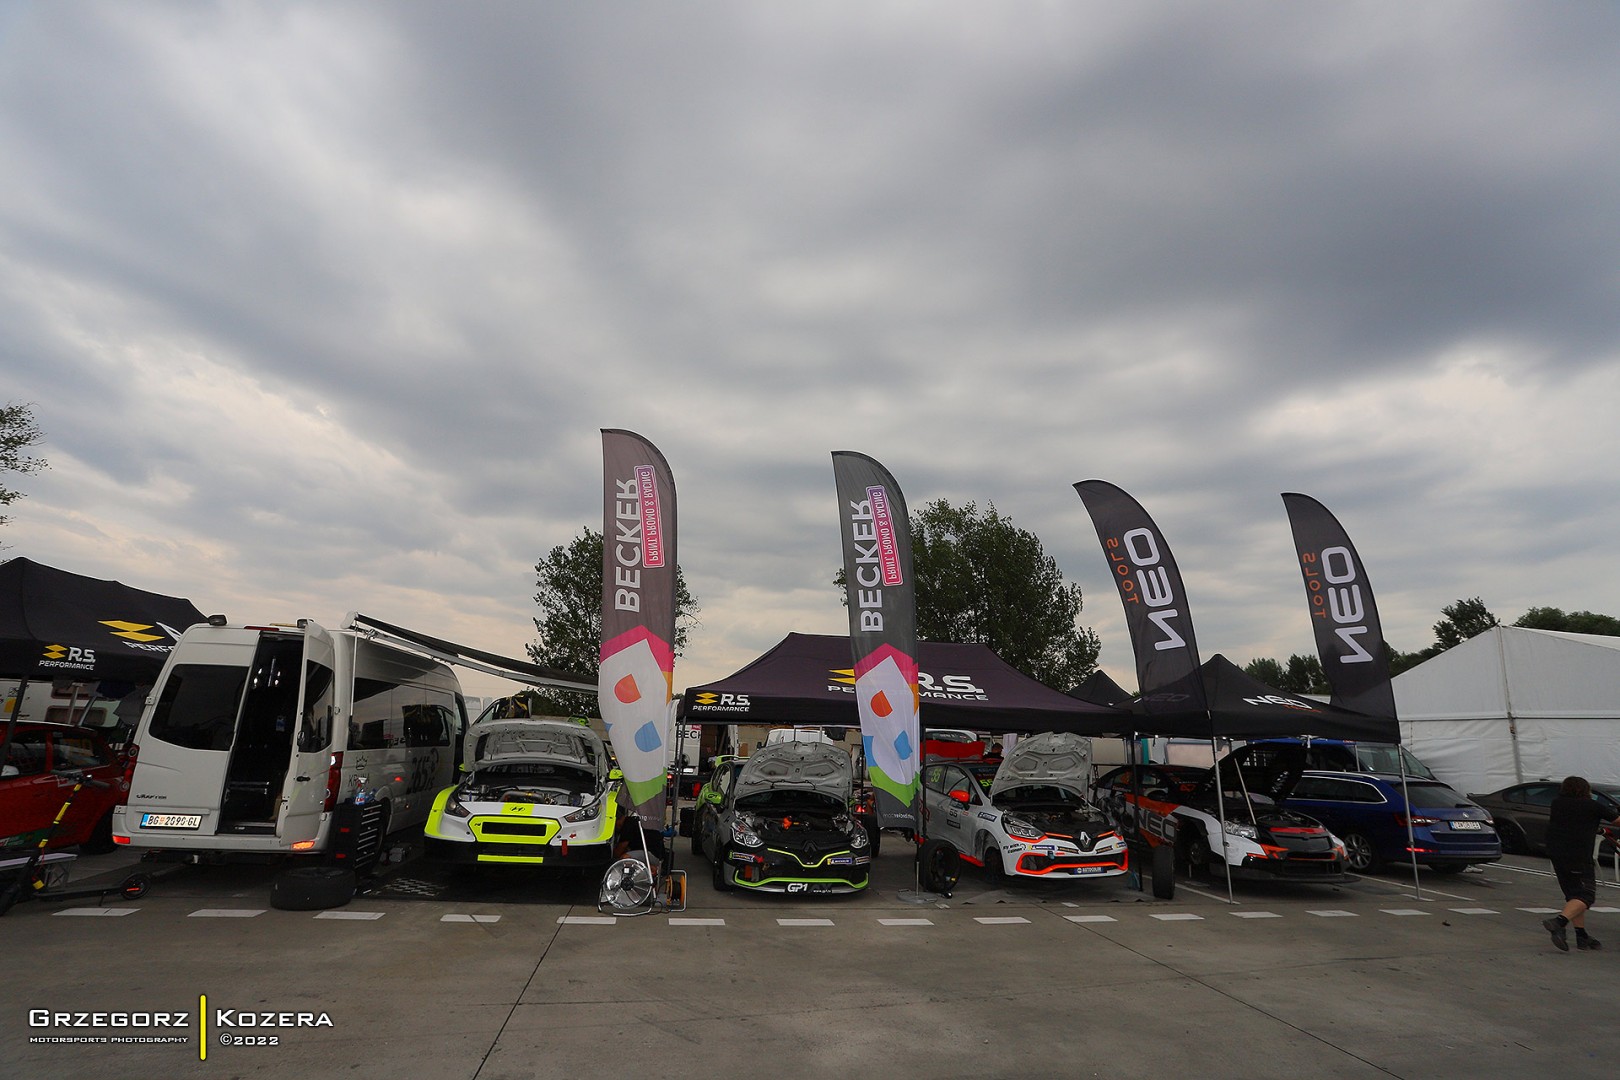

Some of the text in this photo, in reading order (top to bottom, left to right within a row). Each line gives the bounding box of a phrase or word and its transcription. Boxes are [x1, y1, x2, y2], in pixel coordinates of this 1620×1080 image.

[68, 646, 96, 663] R.S.
[39, 660, 95, 671] PERFORMANCE
[720, 693, 751, 706] R.S.
[1242, 695, 1313, 710] NEO
[787, 883, 808, 893] GP1
